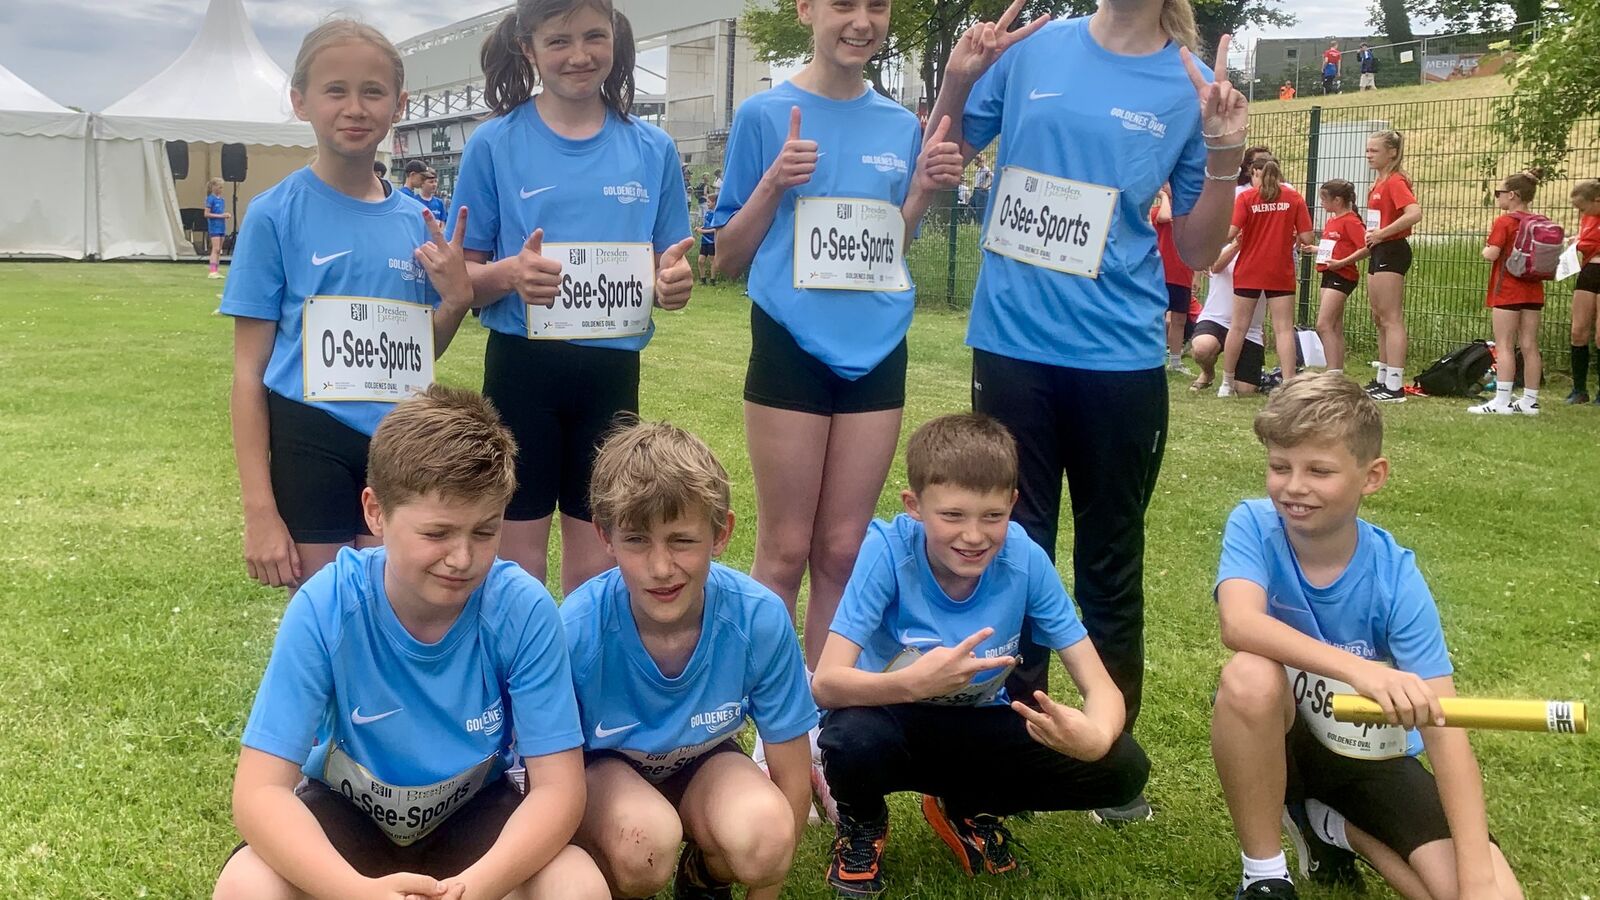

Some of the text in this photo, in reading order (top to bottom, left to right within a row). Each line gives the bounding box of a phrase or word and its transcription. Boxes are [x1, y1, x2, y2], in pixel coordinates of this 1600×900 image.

[1426, 59, 1479, 69] MEHR ALS
[1110, 108, 1149, 127] GOLDENES
[1148, 120, 1167, 135] OVAL
[603, 186, 636, 197] GOLDENES
[1000, 194, 1090, 247] O-See-Sports
[1251, 202, 1290, 214] TALENTS CUP
[810, 227, 894, 271] O-See-Sports
[545, 273, 643, 317] -See-Sports
[321, 329, 421, 379] O-See-Sports
[691, 709, 734, 728] GOLDENES
[1327, 732, 1371, 749] GOLDENES OVAL
[341, 779, 471, 829] O-See-Sports
